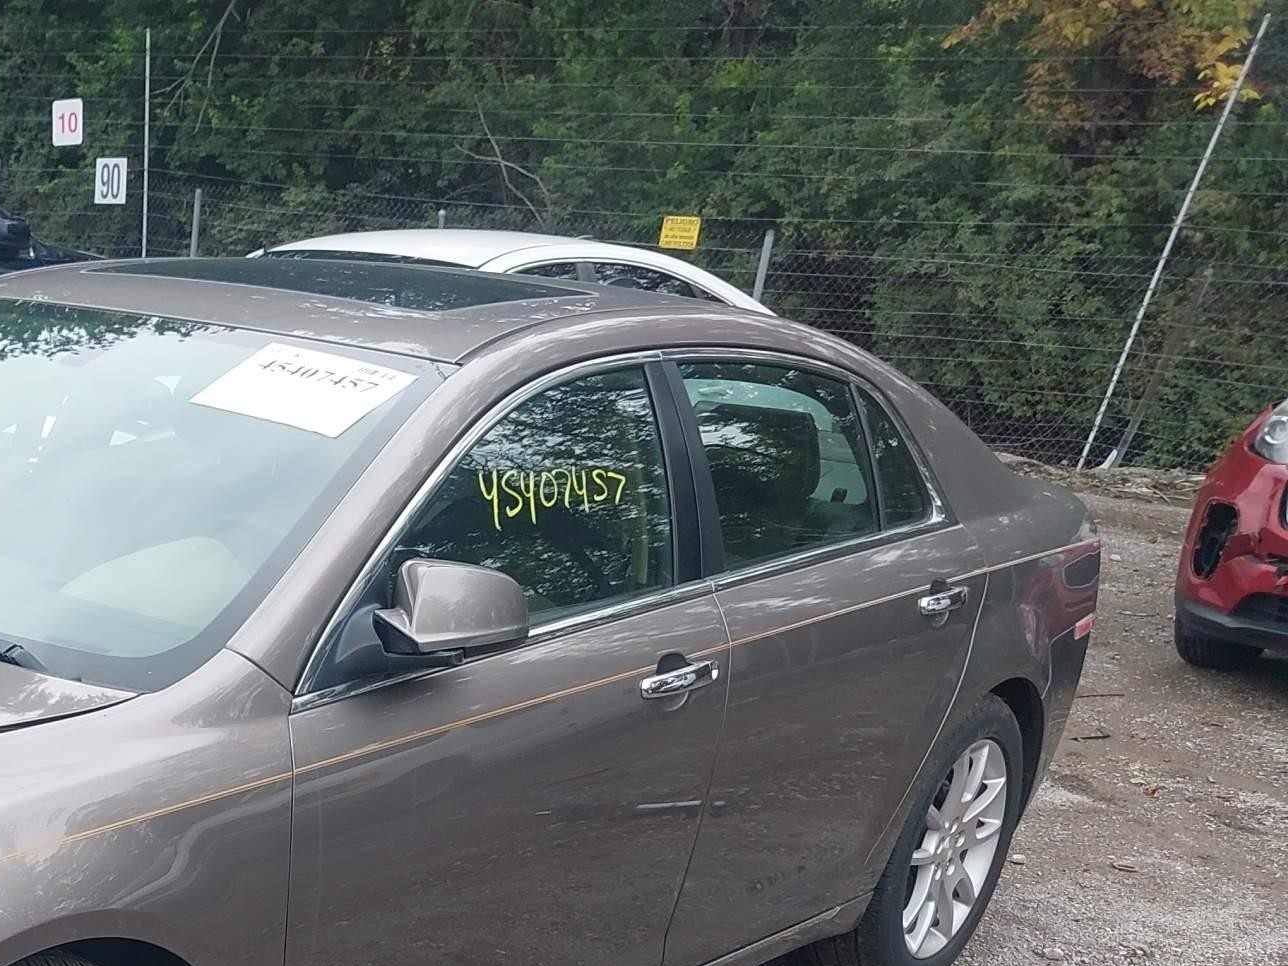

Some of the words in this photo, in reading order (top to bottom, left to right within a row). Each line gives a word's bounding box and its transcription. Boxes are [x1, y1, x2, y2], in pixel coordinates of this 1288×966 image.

[58, 112, 78, 134] 10
[100, 163, 121, 199] 90
[259, 359, 380, 393] 45407457
[478, 466, 626, 531] 45407457
